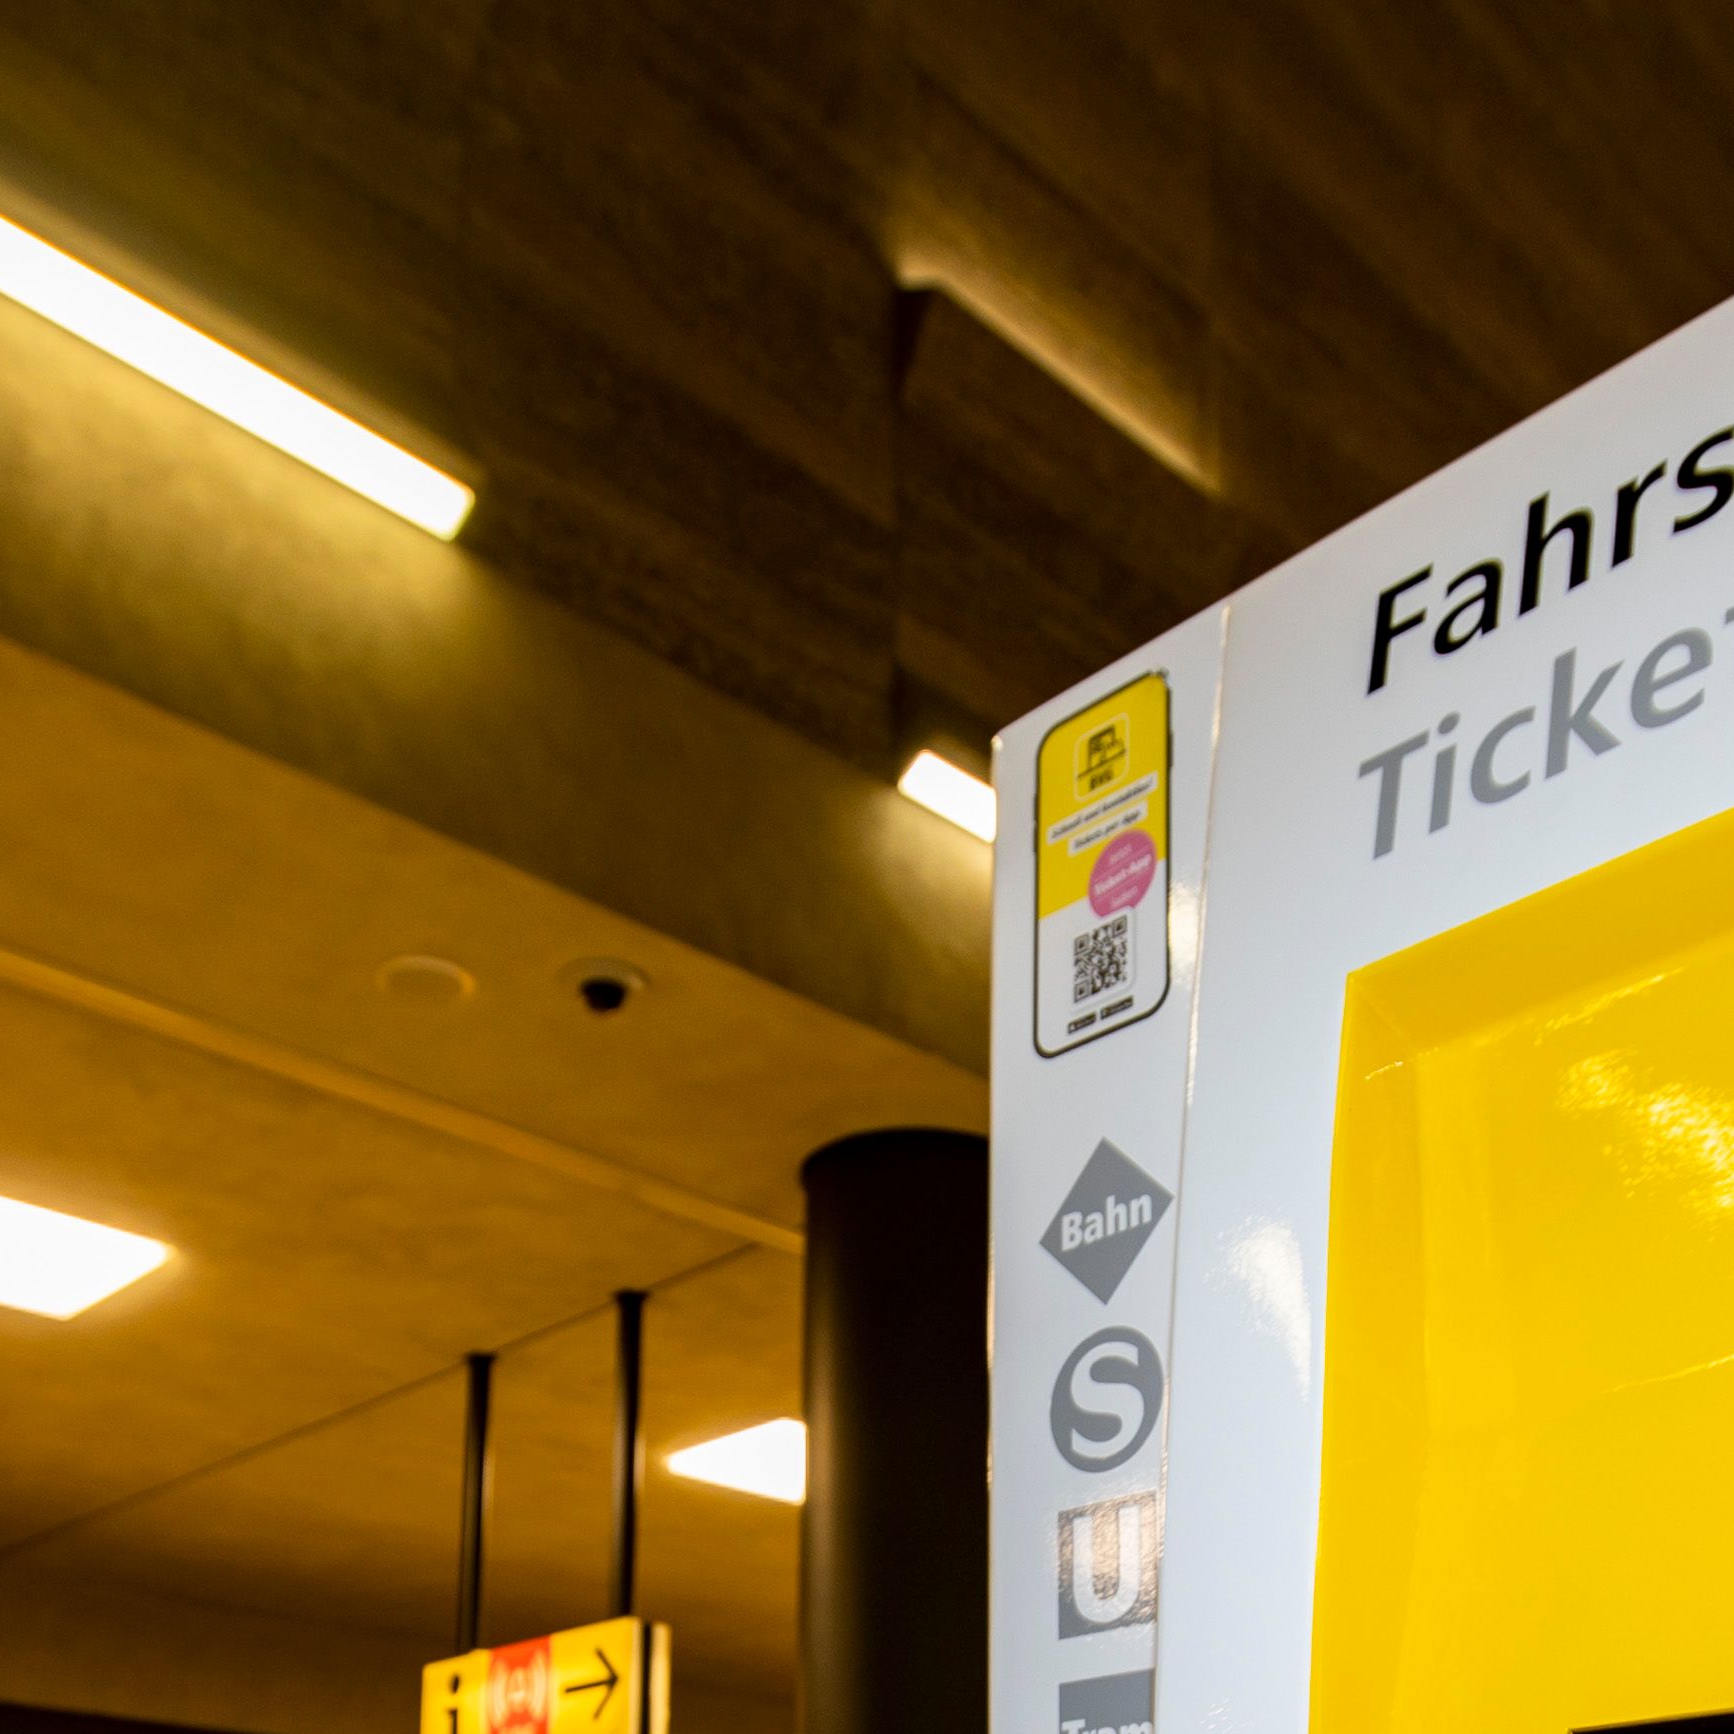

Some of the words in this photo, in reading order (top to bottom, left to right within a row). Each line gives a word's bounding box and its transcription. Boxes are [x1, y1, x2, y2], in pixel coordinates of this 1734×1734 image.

[1061, 1192, 1153, 1252] Bahn
[1071, 1340, 1145, 1459] S
[1072, 1504, 1141, 1624] U
